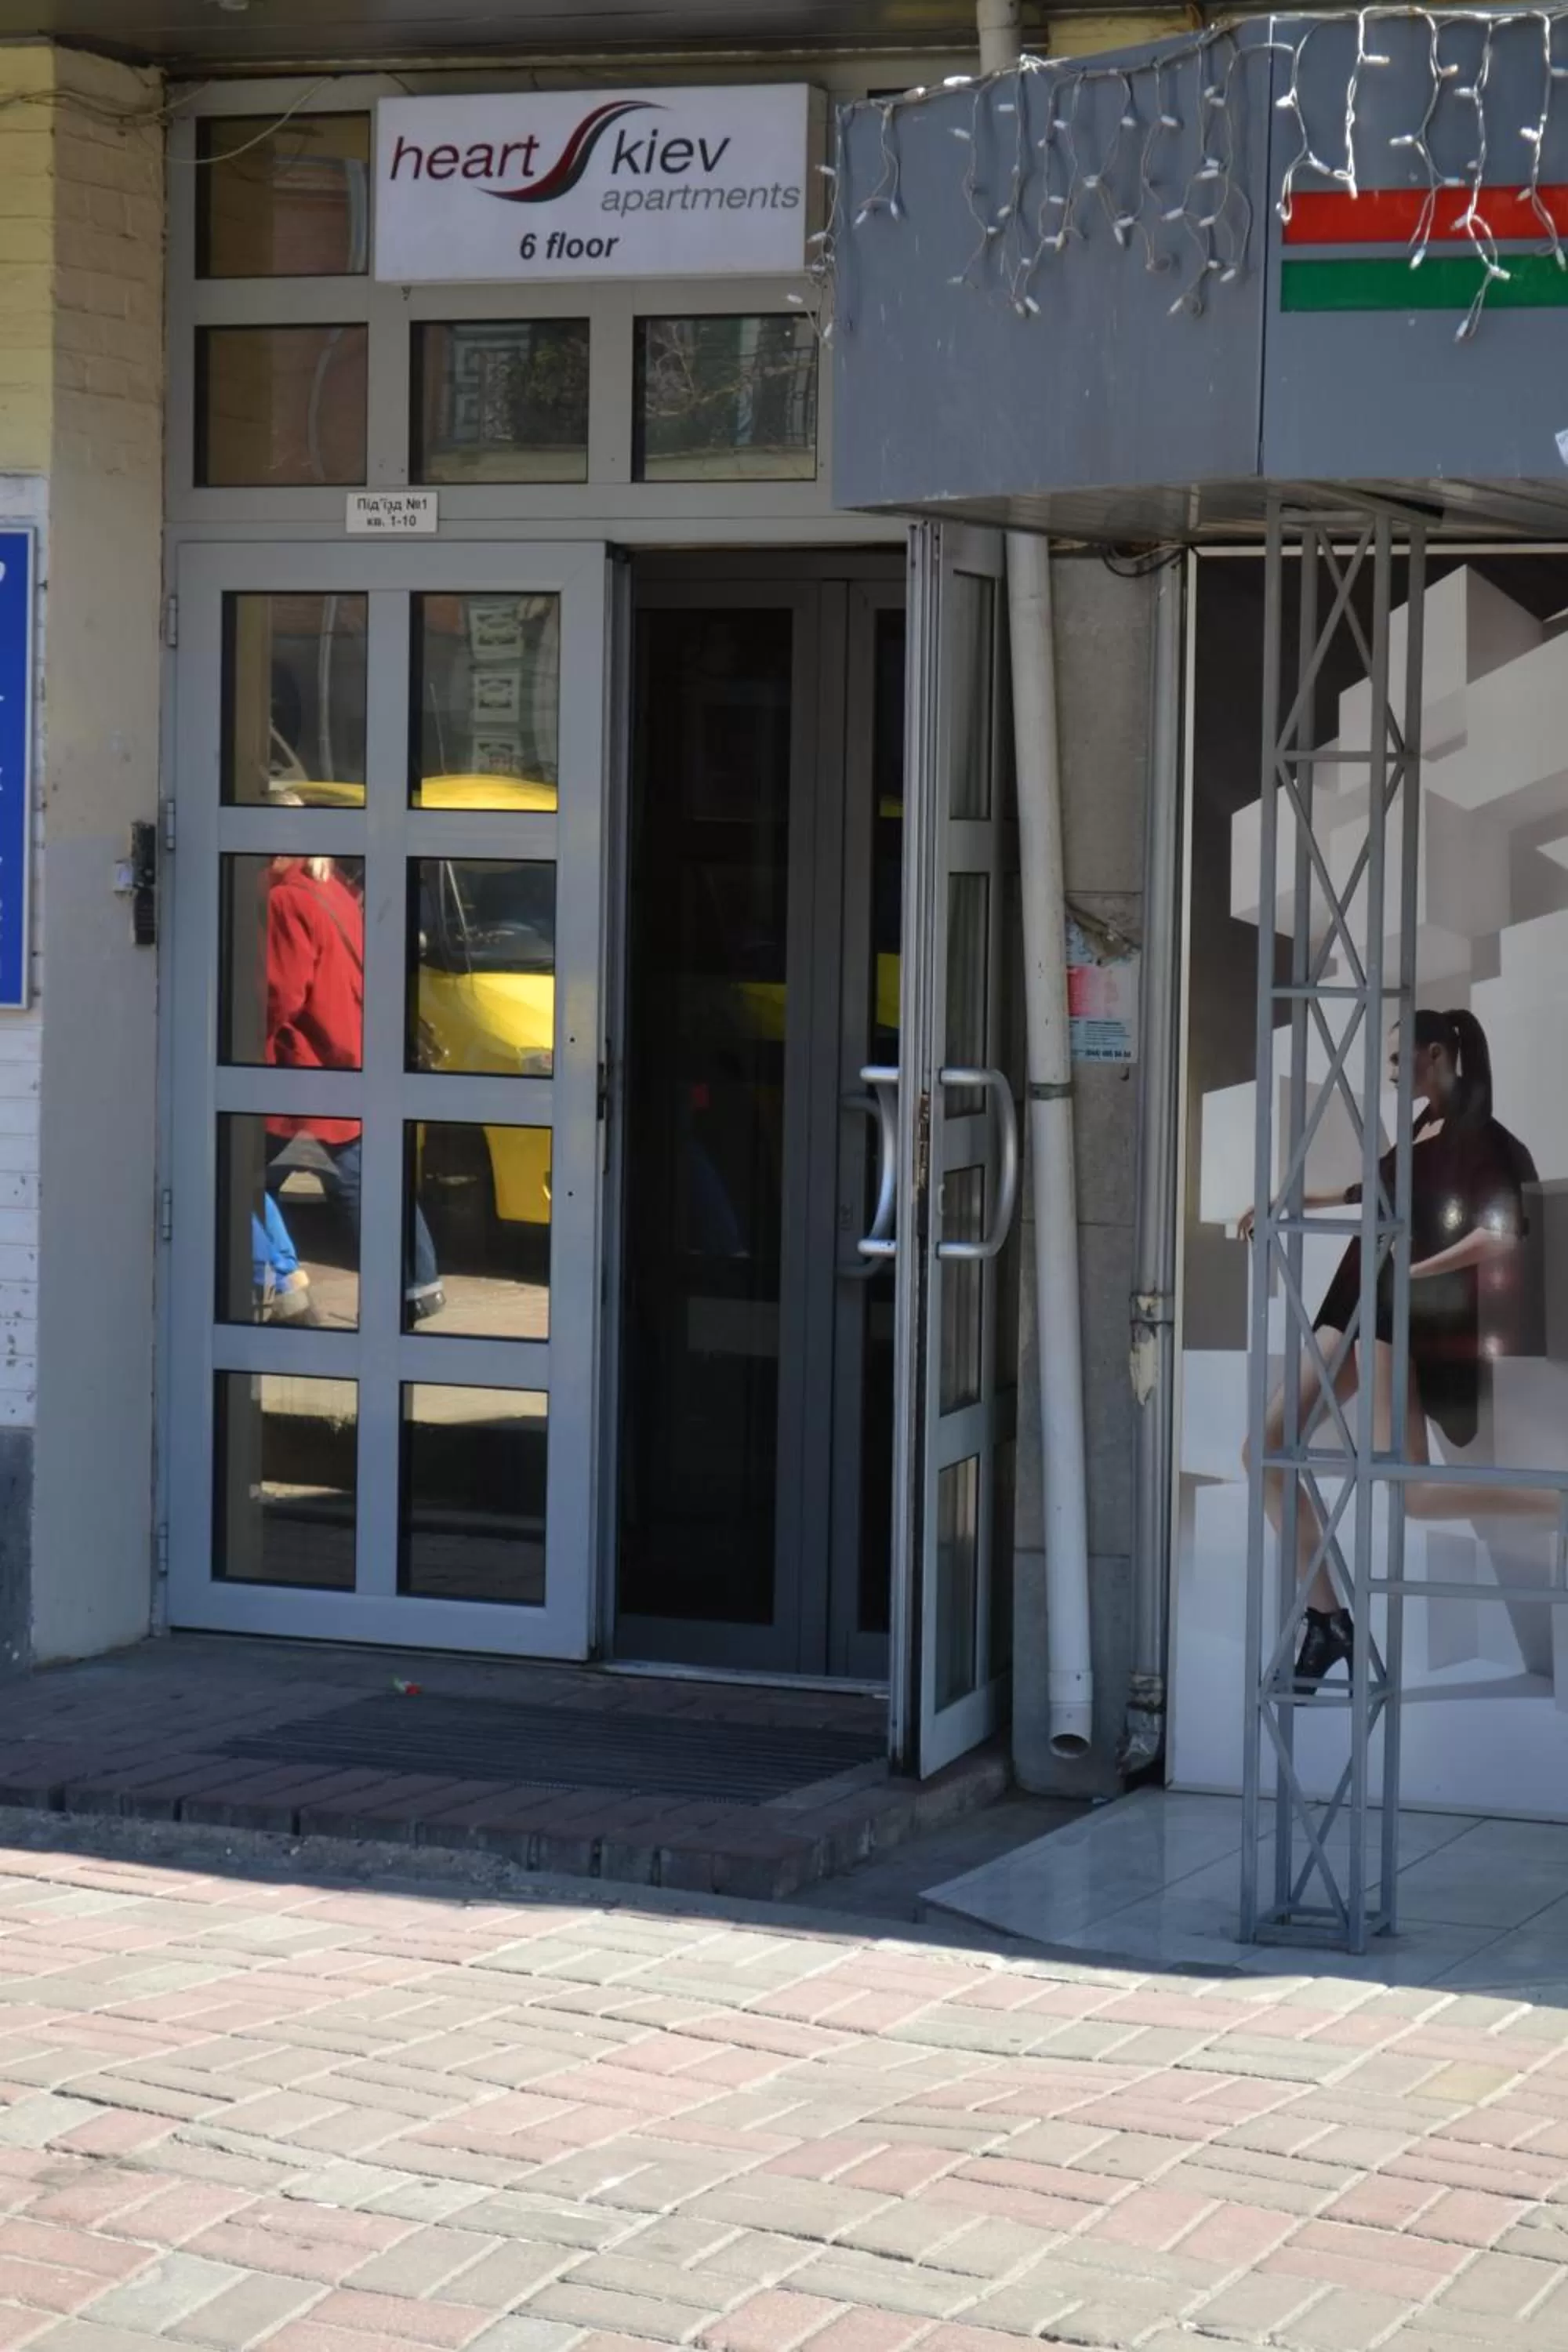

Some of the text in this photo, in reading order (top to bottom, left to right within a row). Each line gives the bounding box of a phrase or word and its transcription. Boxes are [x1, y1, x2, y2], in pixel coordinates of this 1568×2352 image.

[390, 129, 731, 180] heart kiev
[601, 182, 801, 218] apartments
[519, 232, 619, 260] 6 floor
[391, 514, 417, 527] 1-10
